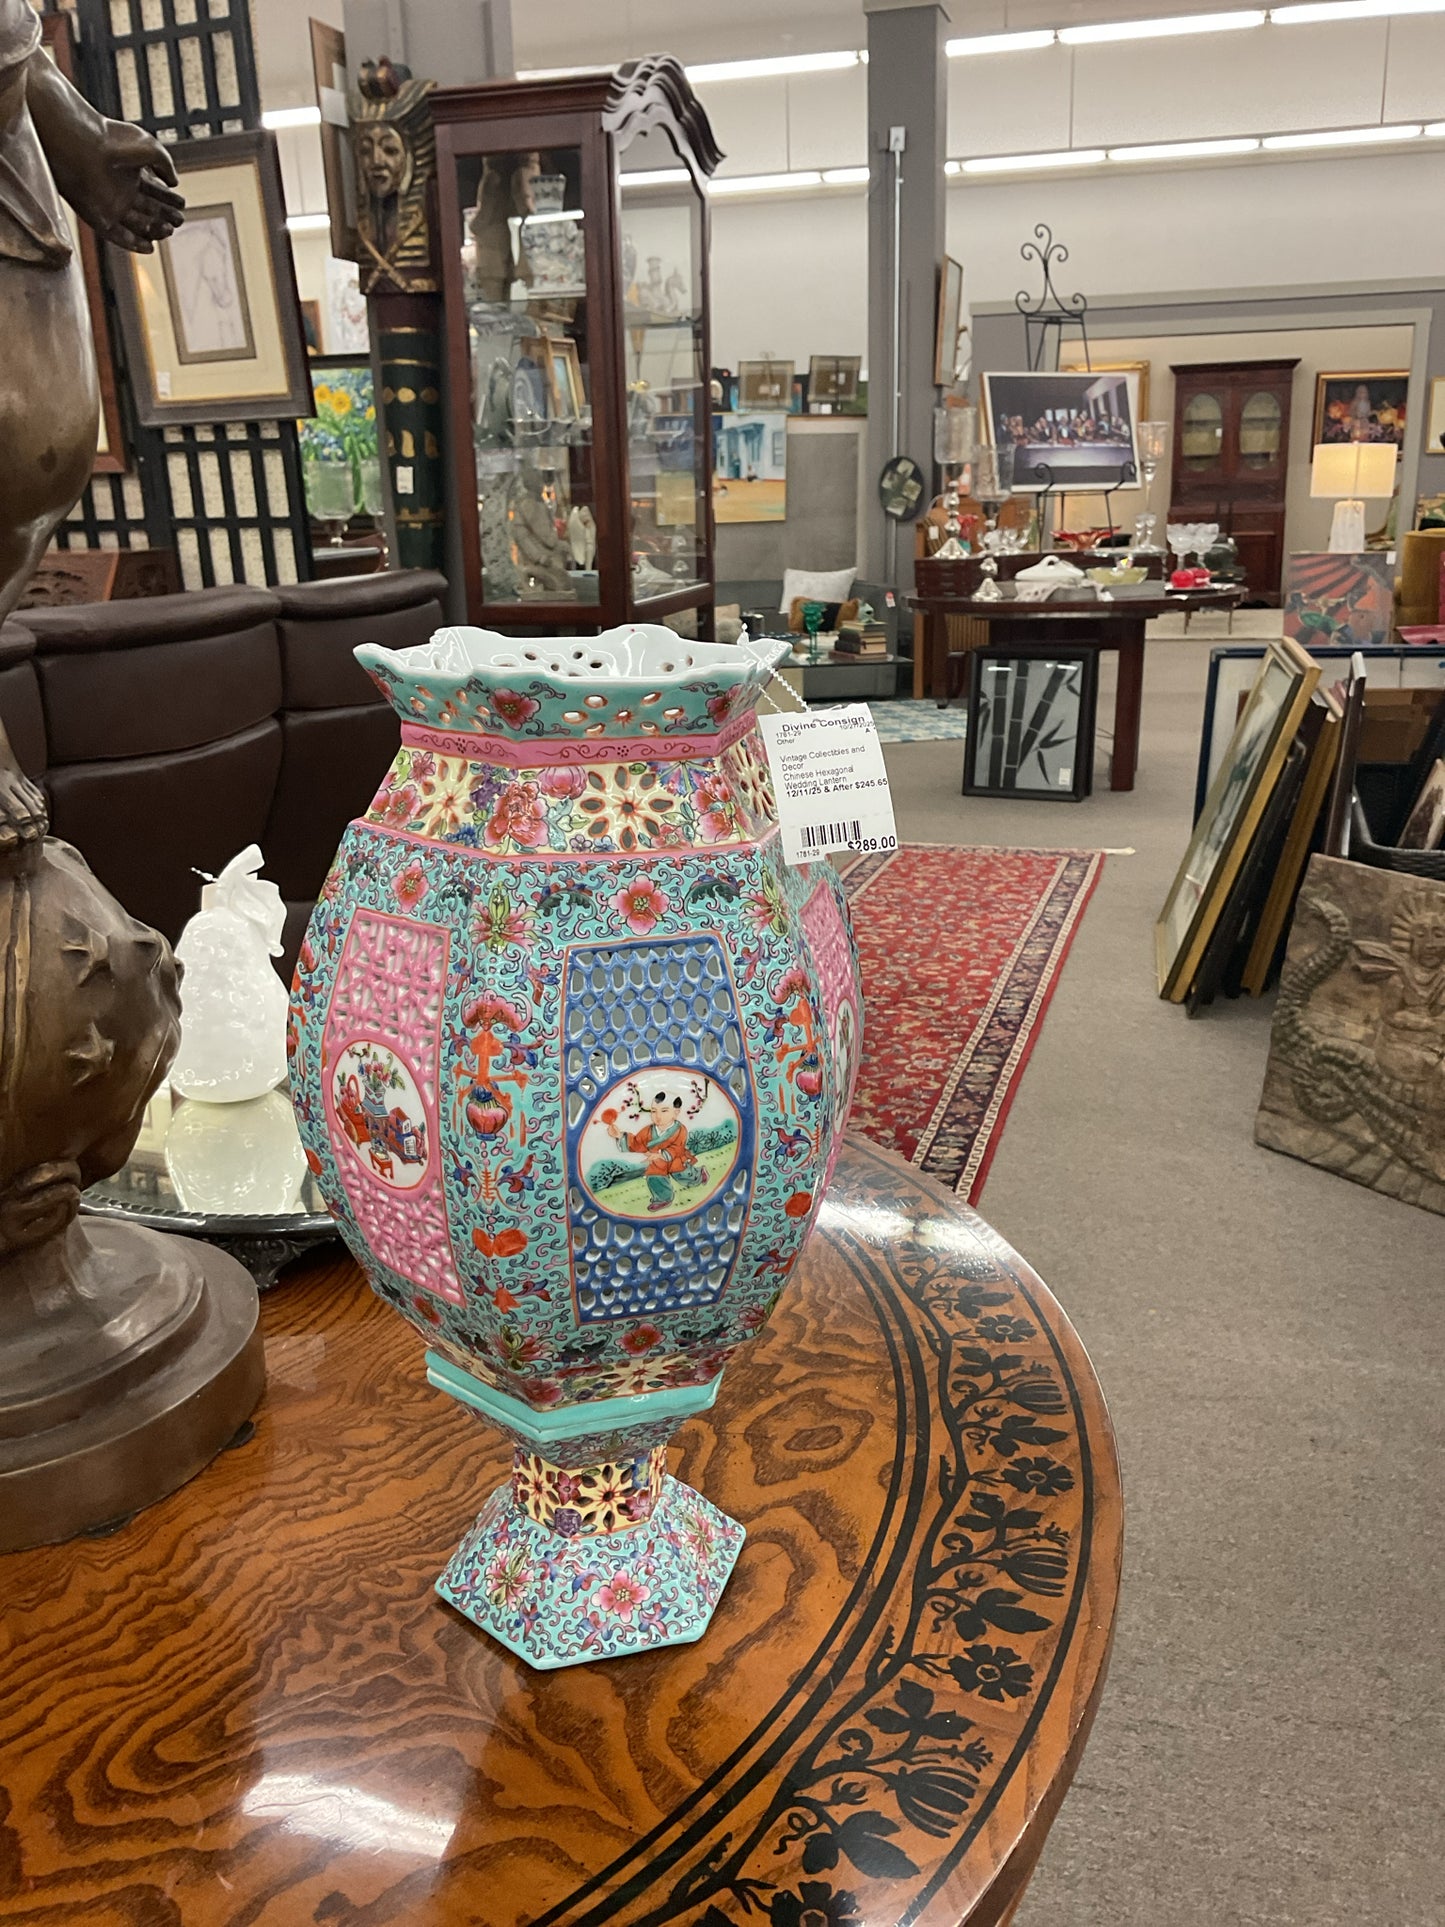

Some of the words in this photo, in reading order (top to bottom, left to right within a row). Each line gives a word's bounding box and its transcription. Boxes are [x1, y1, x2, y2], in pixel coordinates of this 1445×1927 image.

[782, 722, 816, 732] Divine
[819, 716, 865, 728] Consign
[780, 753, 808, 763] Vintage
[808, 748, 850, 759] Collectibles
[852, 746, 866, 754] and
[782, 763, 804, 772] Decor
[783, 772, 814, 782] Chinese
[816, 764, 854, 777] Hexagonal
[784, 779, 818, 790] Wedding
[819, 776, 847, 786] Lantern
[786, 786, 822, 798] 12/11/25
[832, 782, 853, 792] After
[854, 778, 888, 790] $245.65
[847, 835, 896, 852] $289.00
